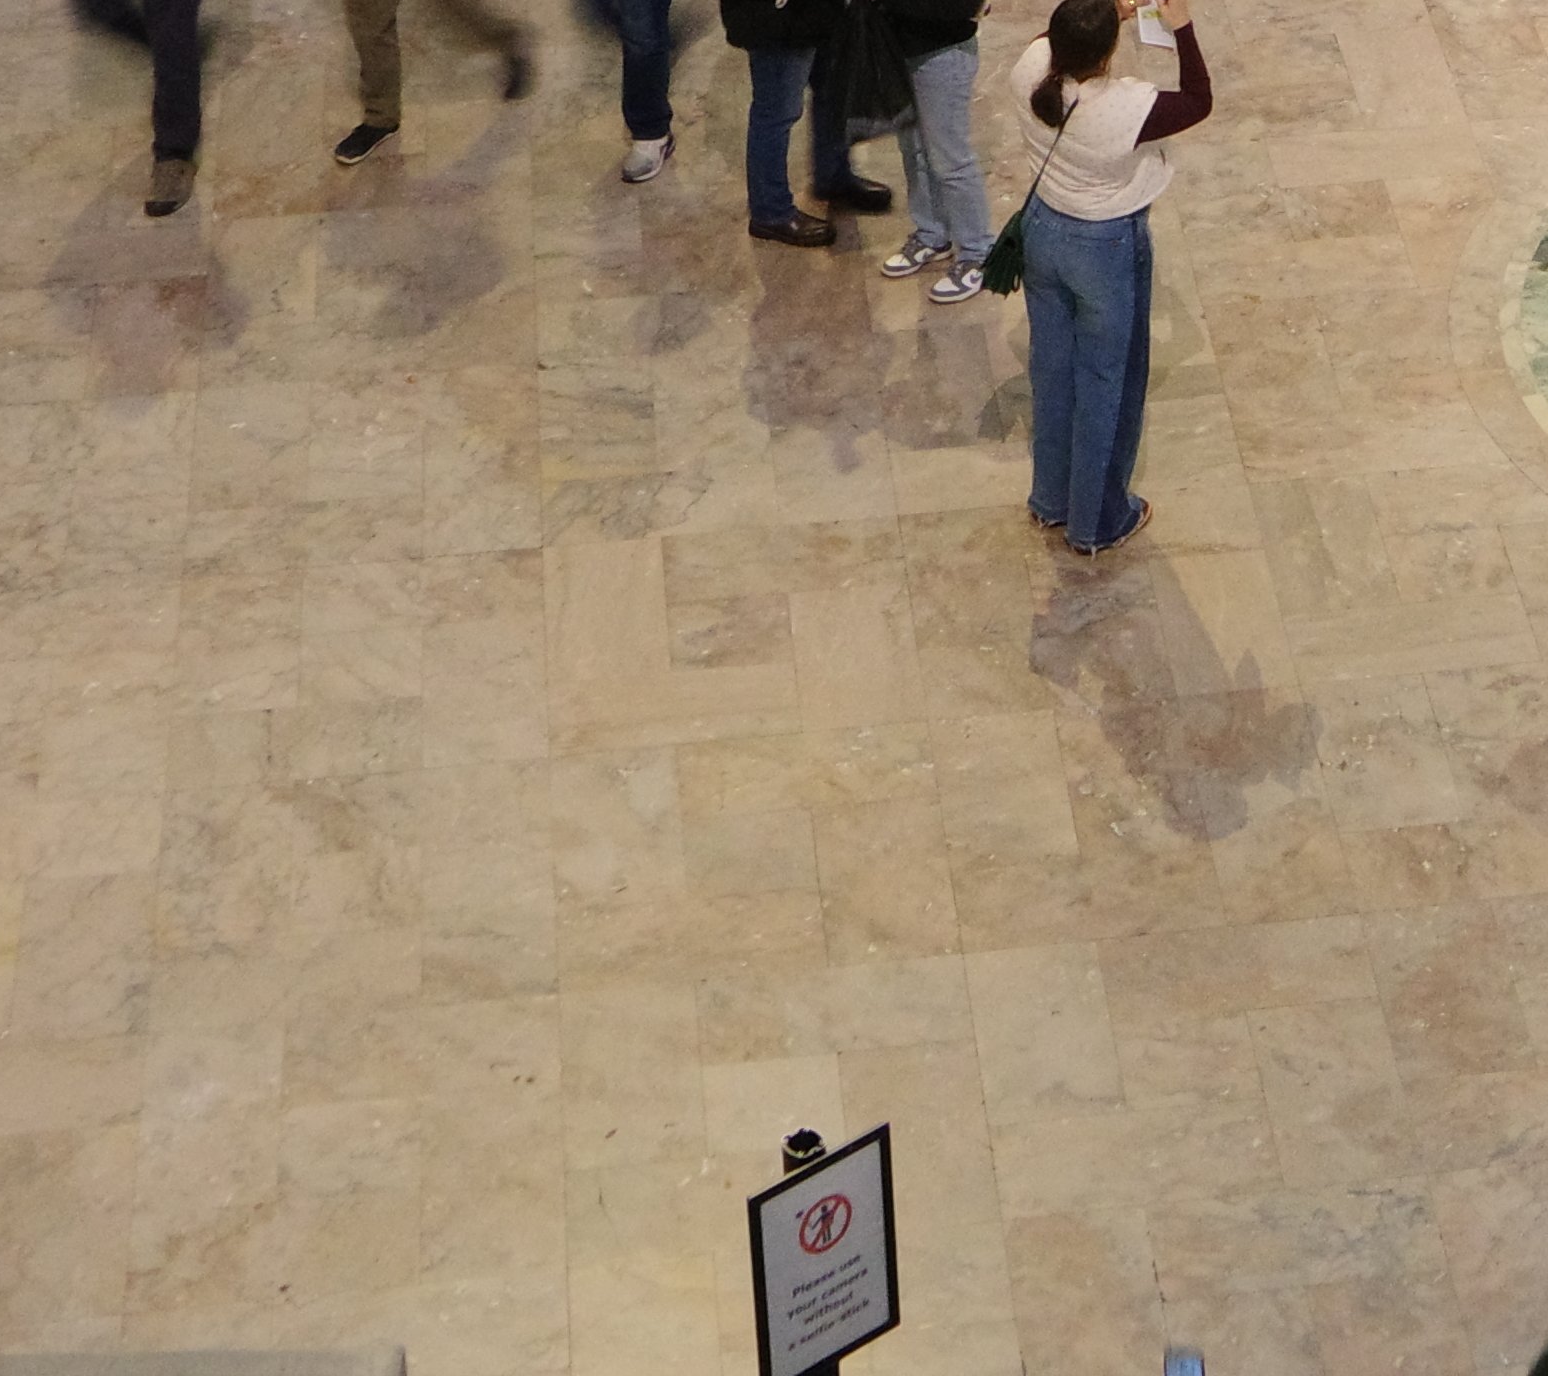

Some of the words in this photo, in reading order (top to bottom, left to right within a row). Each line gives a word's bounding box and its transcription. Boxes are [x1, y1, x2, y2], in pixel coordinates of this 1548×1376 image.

[787, 1298, 817, 1321] your
[821, 1268, 868, 1301] camera
[792, 1270, 836, 1299] Please
[804, 1291, 853, 1325] without
